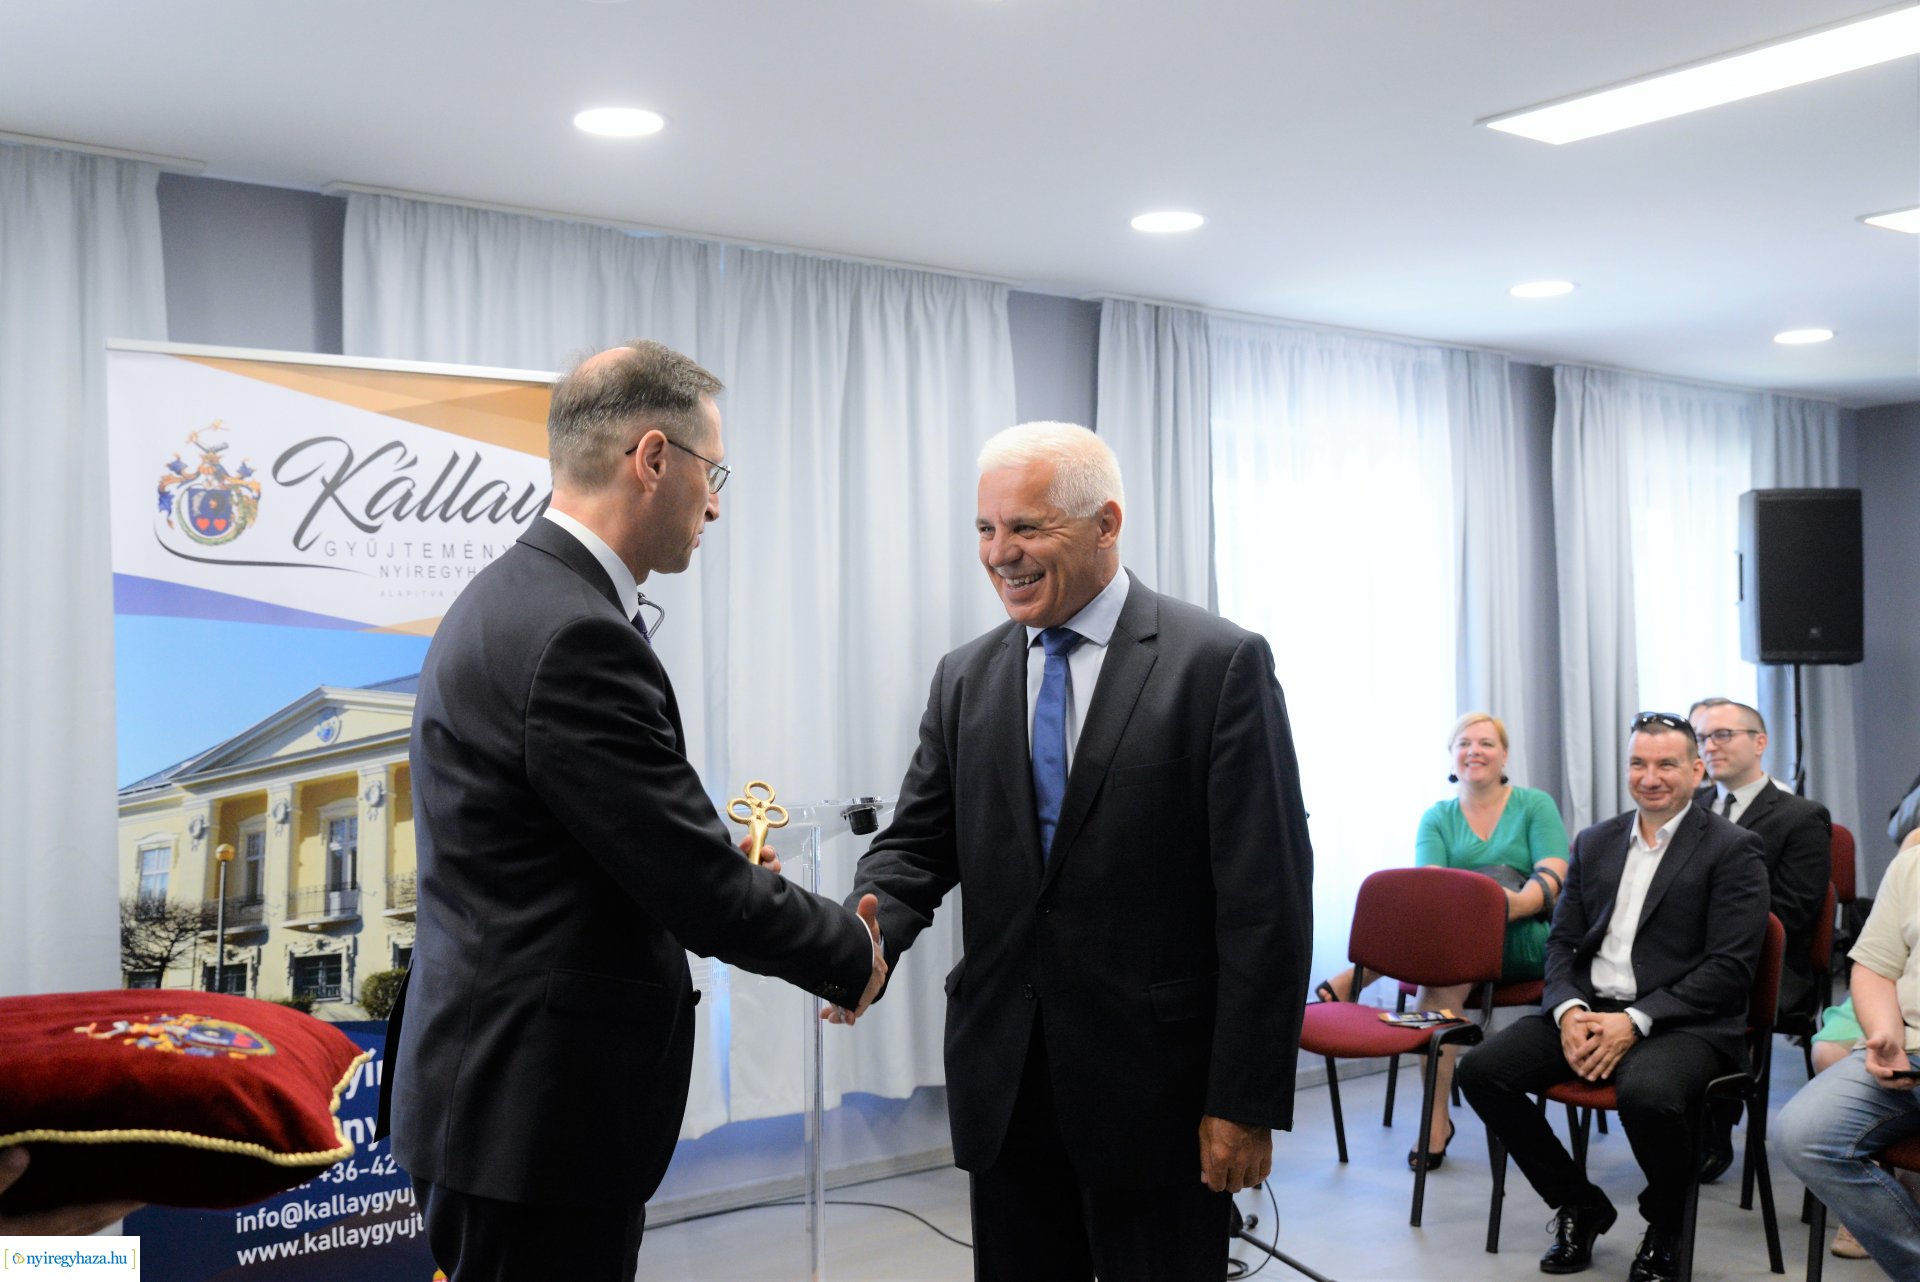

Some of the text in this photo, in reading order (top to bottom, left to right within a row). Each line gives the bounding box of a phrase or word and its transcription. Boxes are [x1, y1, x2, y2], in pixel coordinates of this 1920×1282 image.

[379, 562, 484, 579] NYÍREGYH
[319, 1153, 400, 1184] +36-42
[237, 1212, 425, 1266] www.kallaygyujt
